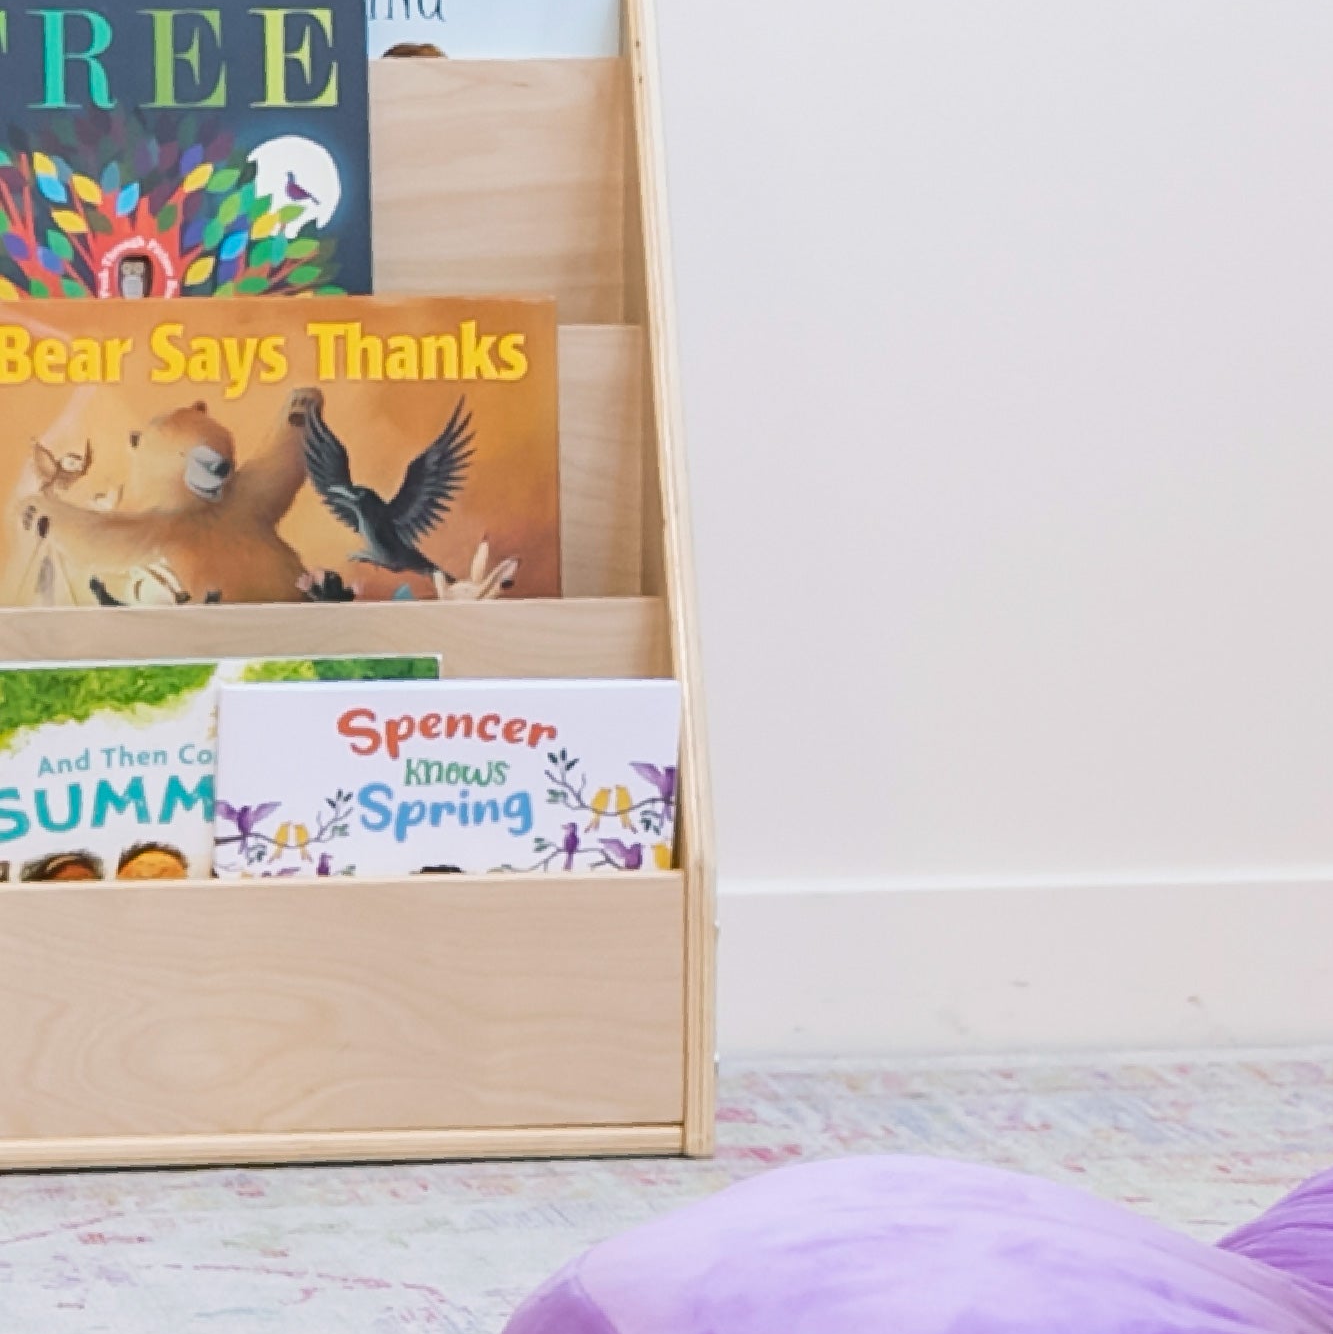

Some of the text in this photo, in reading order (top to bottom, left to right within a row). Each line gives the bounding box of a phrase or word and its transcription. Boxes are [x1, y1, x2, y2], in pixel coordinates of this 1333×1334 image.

[0, 8, 339, 109] REE
[0, 319, 529, 400] Bear Says Thanks
[38, 747, 91, 777] And
[100, 744, 168, 769] Then
[336, 707, 558, 760] Spencer
[356, 781, 534, 843] Spring
